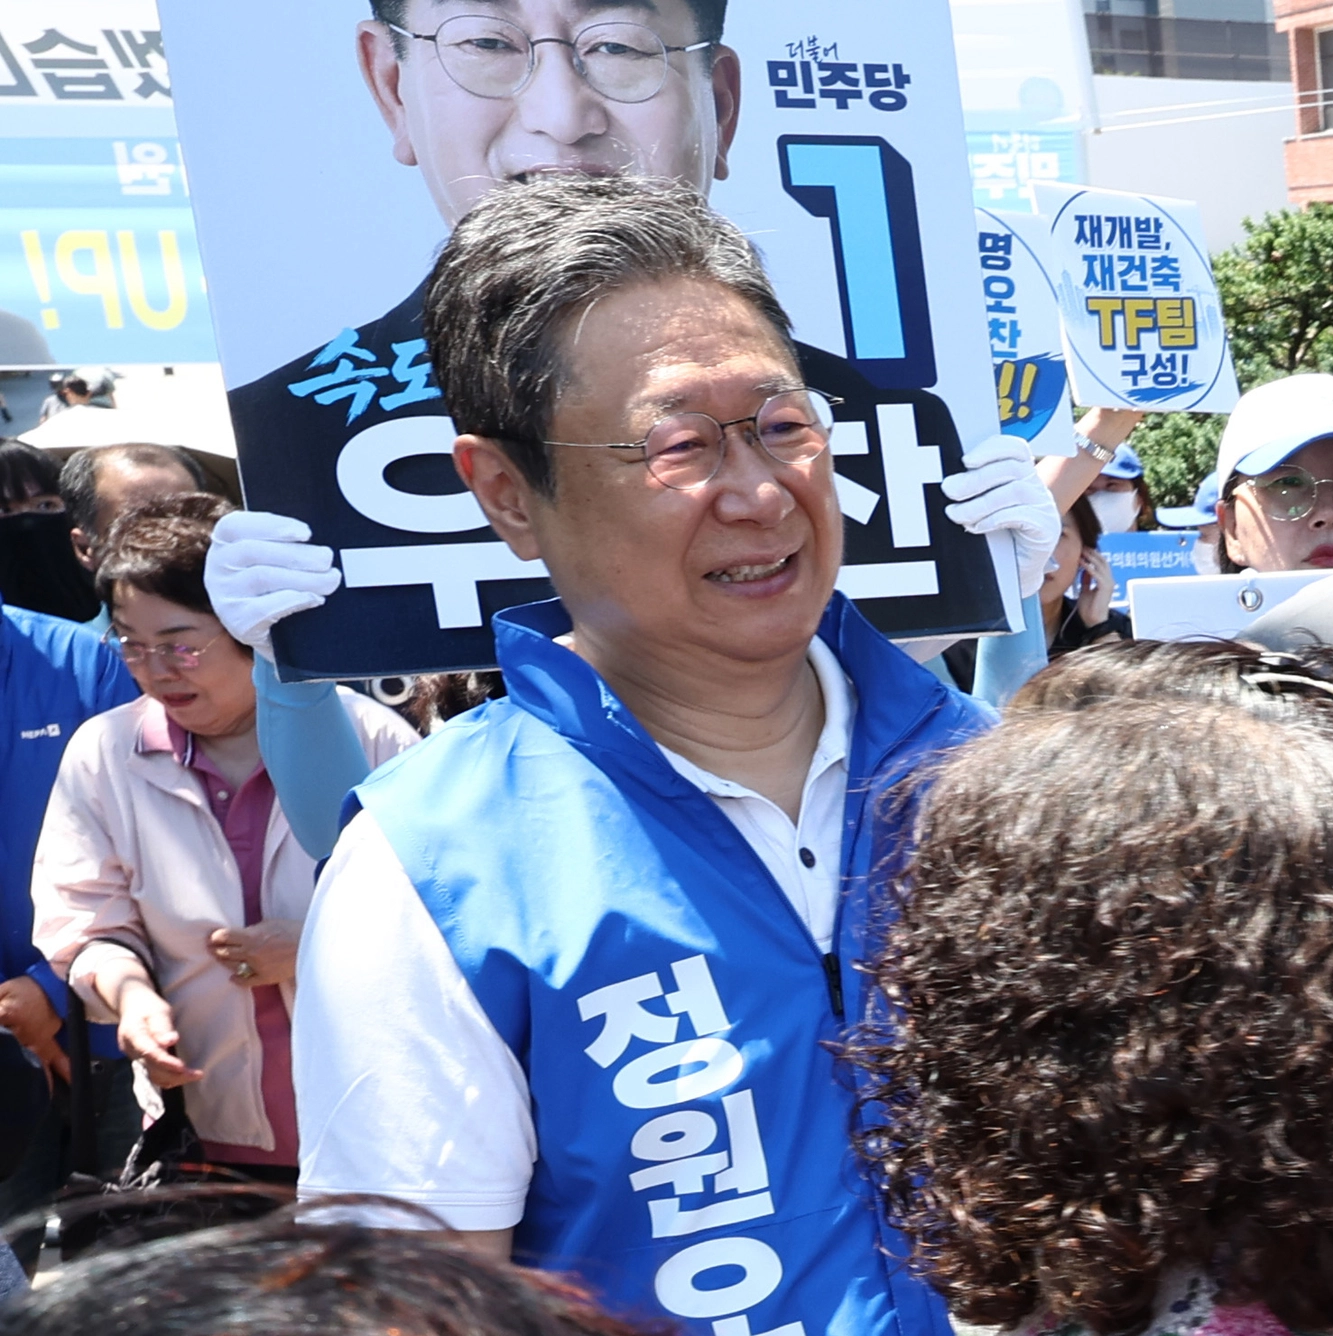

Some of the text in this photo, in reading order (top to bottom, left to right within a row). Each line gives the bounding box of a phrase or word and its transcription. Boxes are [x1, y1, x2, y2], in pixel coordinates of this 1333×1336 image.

[785, 35, 840, 64] 더불어
[766, 60, 911, 112] 민주당
[1074, 214, 1171, 251] 재개발,
[777, 134, 939, 389] 1
[1082, 254, 1181, 292] 재건축
[1086, 296, 1198, 350] TF팀
[1121, 353, 1189, 387] 구성!
